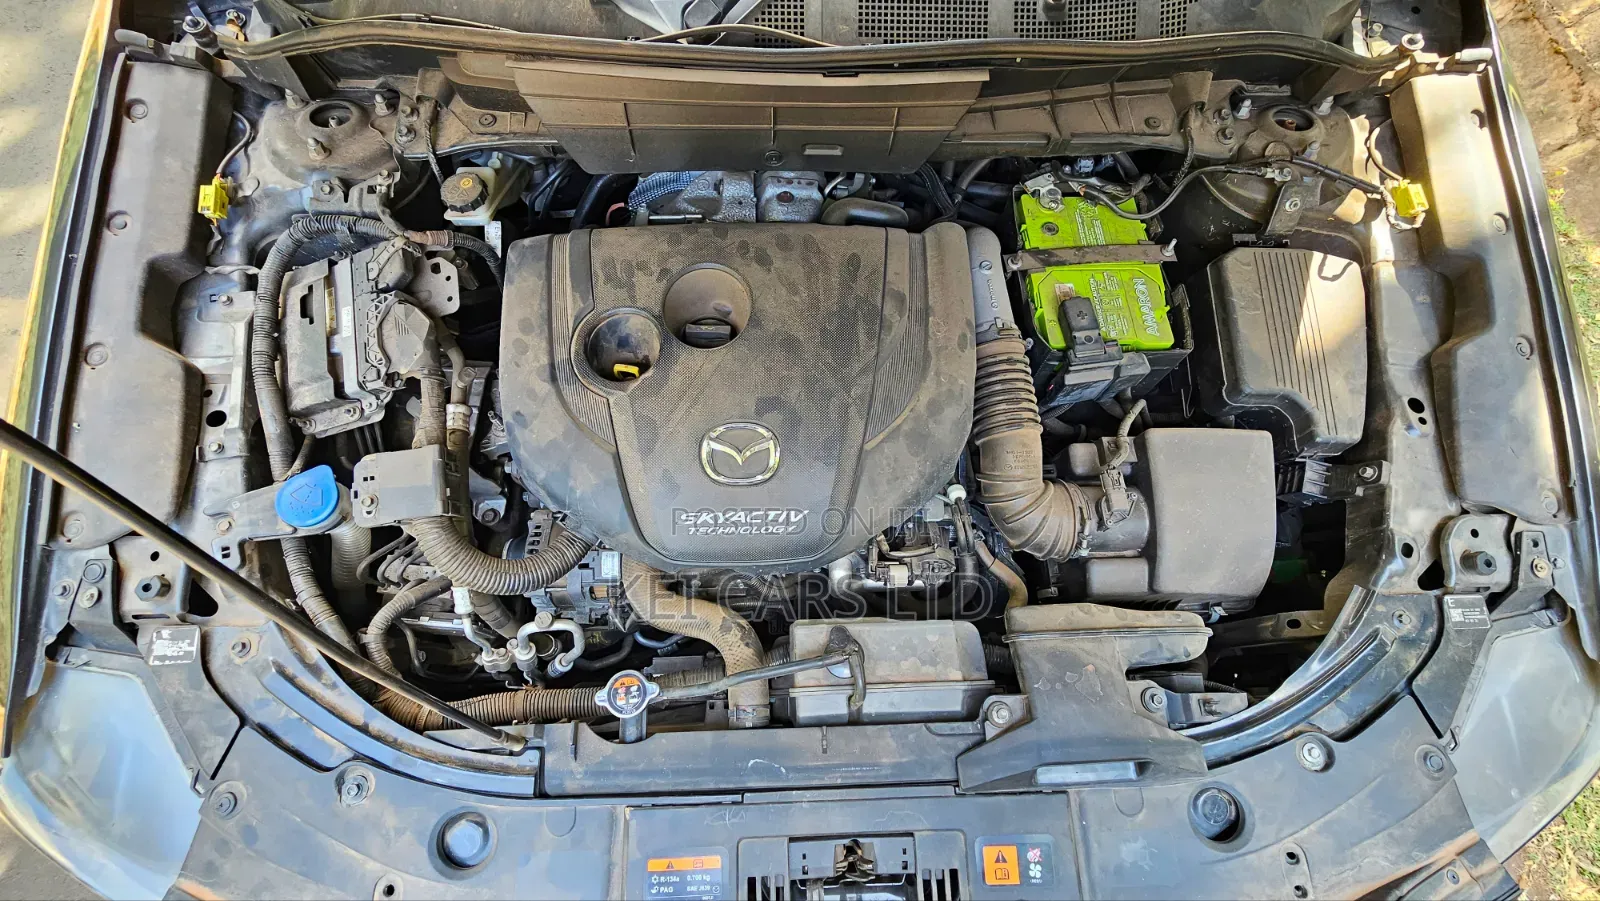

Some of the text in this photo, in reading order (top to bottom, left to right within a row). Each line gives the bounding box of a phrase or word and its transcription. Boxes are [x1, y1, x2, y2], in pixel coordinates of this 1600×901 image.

[1133, 278, 1160, 336] AMARON
[681, 510, 809, 525] SKYACTIV
[688, 525, 798, 535] TECHNOLOGY
[660, 875, 679, 883] R-134a
[702, 874, 711, 882] kg
